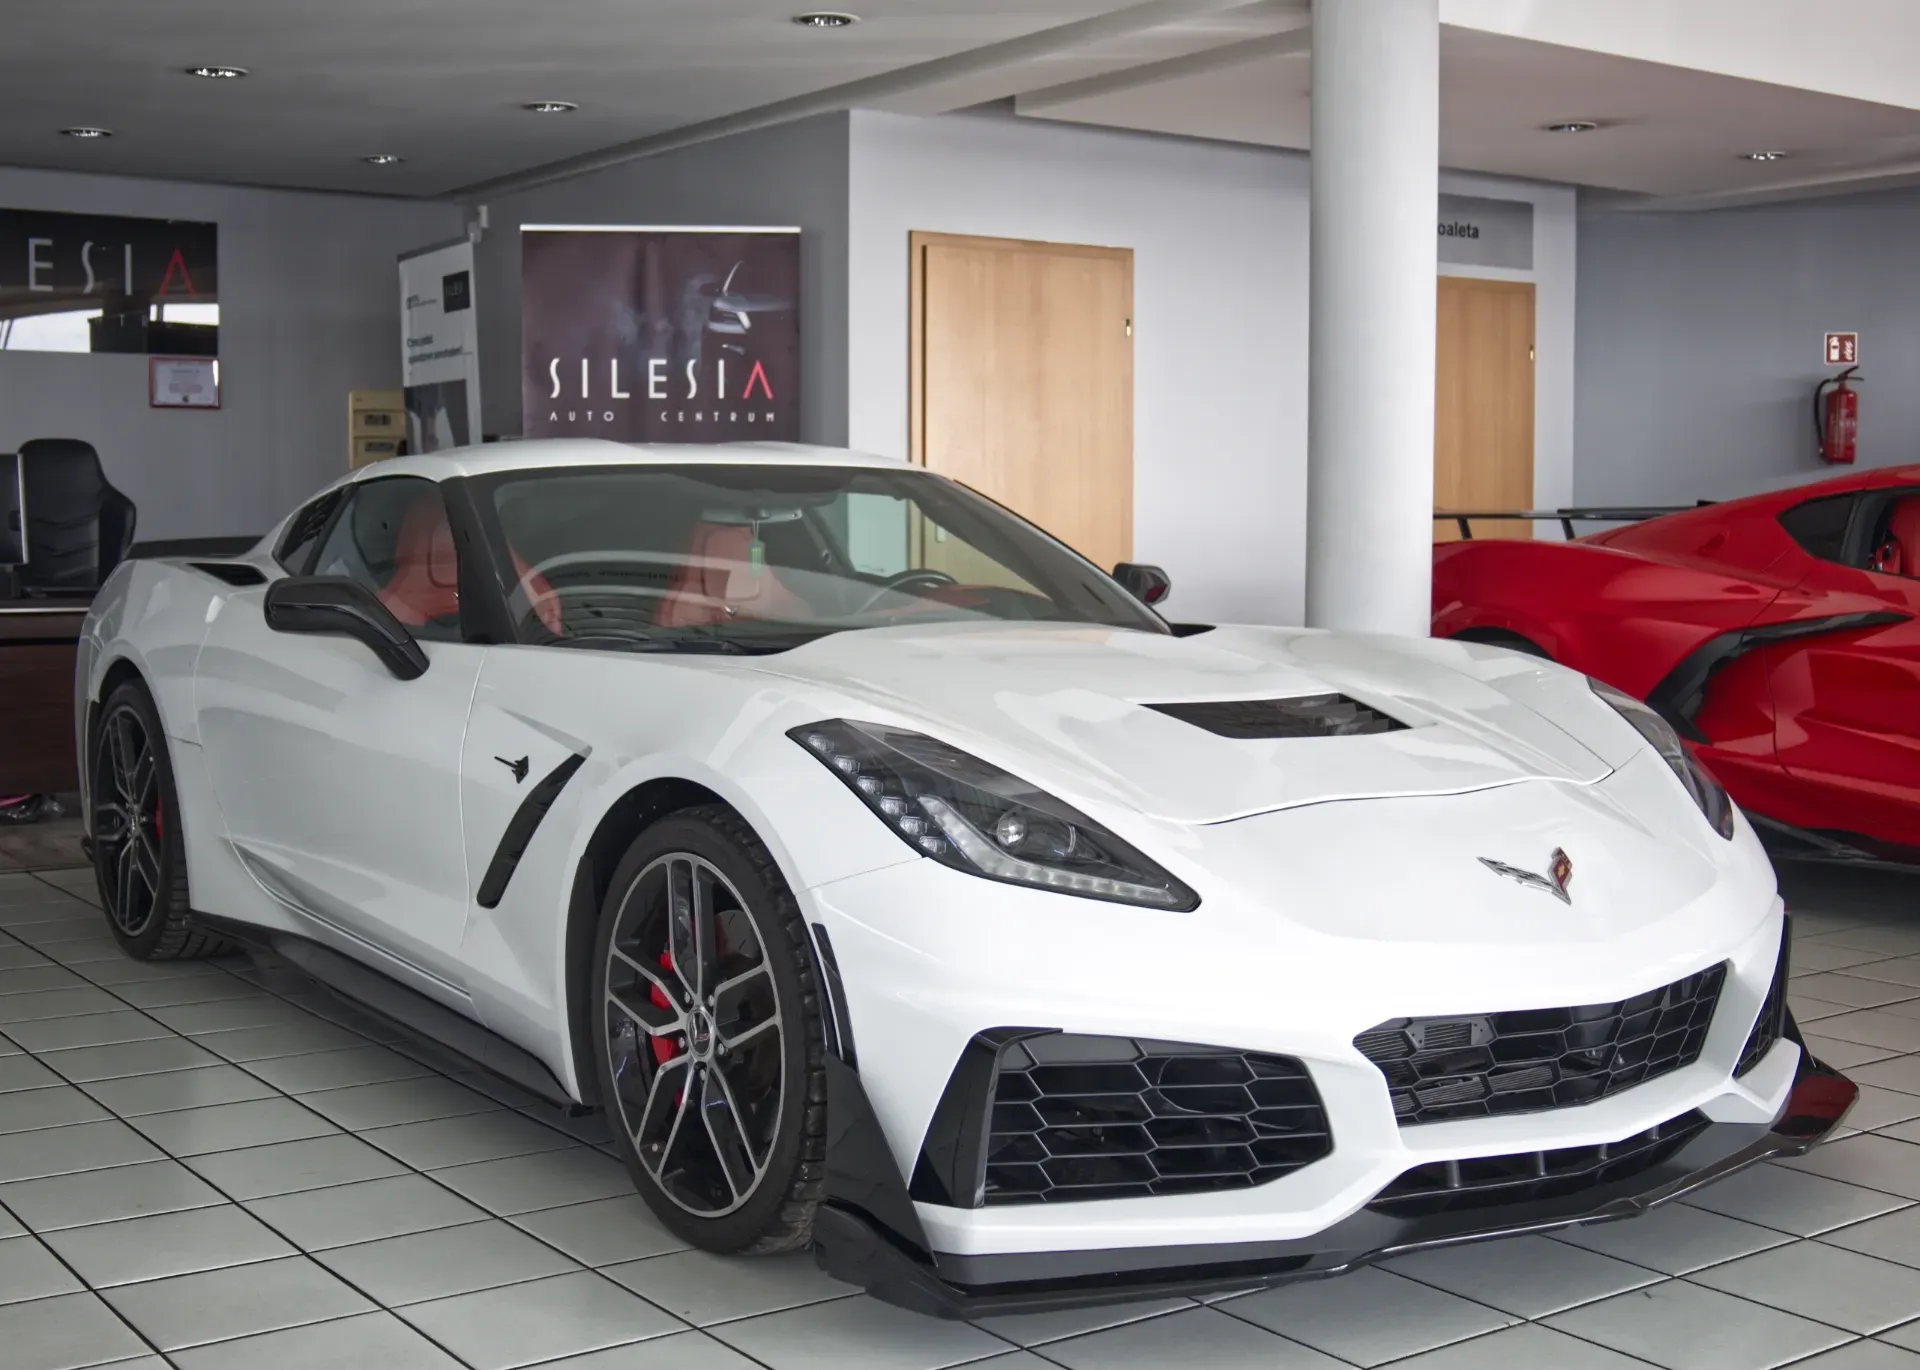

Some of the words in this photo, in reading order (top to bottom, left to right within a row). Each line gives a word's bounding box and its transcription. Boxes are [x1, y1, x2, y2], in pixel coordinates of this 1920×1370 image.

[1438, 220, 1479, 239] oaleta
[0, 237, 197, 298] ESIA
[549, 357, 774, 399] SILESIA
[549, 411, 614, 422] AUTO
[660, 411, 774, 422] CENTRUM
